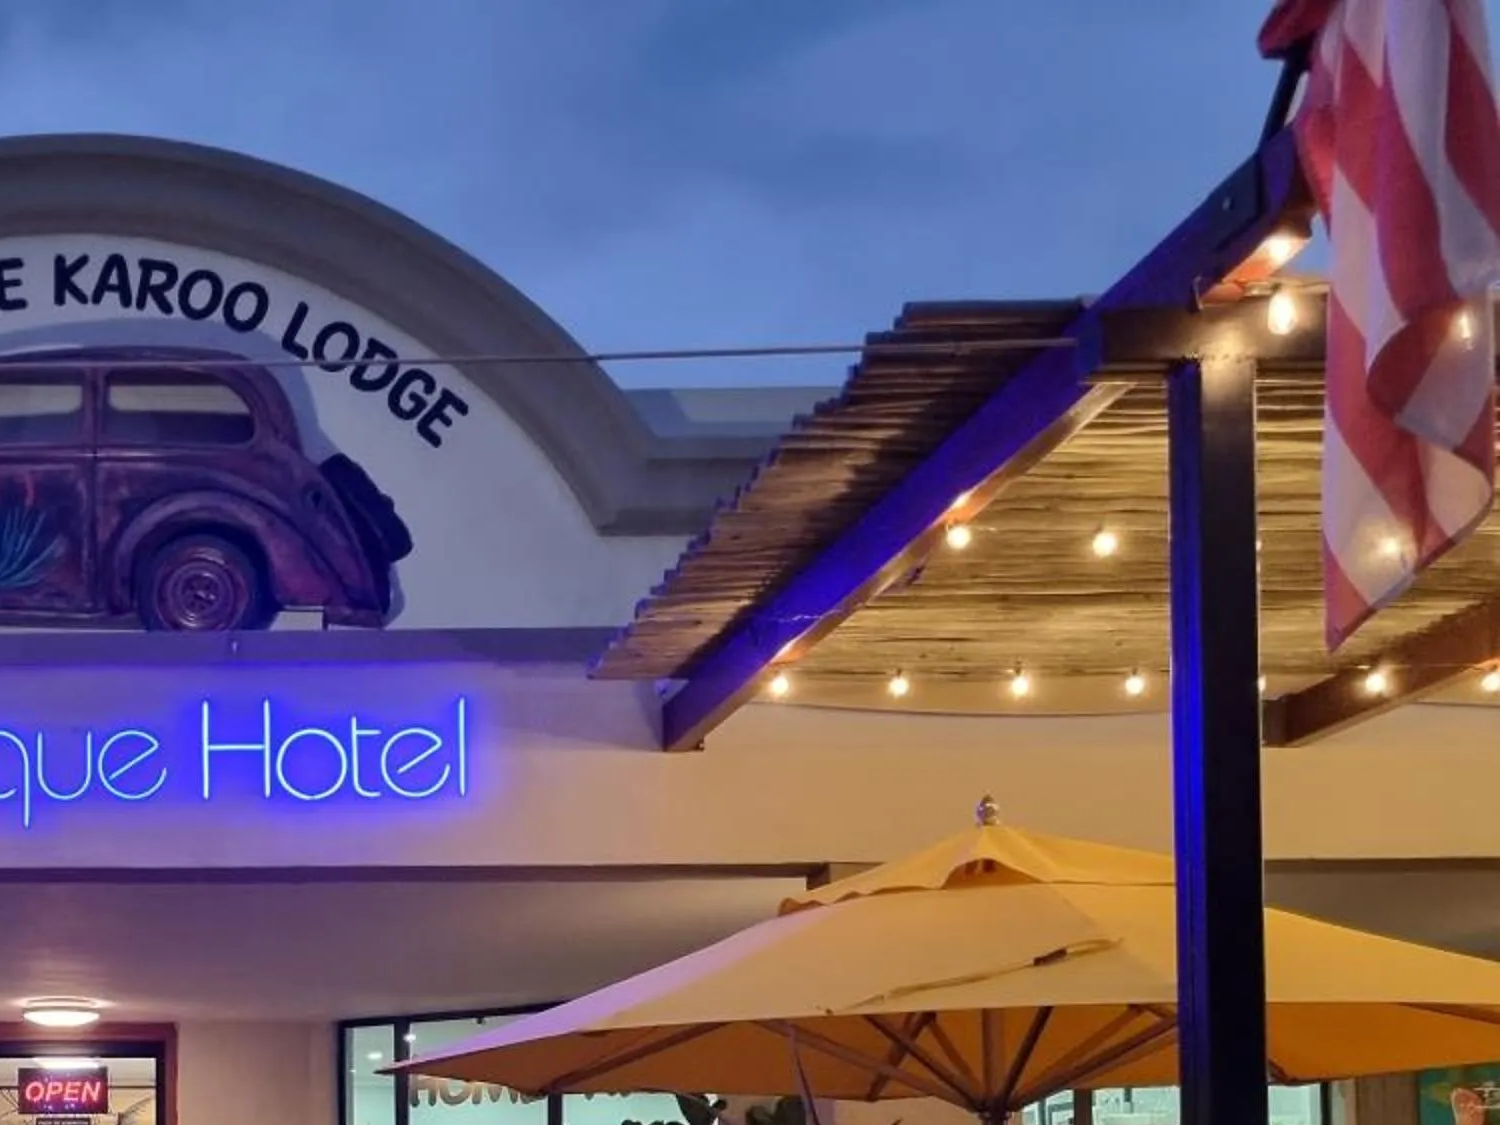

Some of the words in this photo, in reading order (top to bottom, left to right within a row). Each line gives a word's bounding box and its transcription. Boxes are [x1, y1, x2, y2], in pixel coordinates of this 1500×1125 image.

[53, 253, 270, 334] KAROO
[282, 301, 470, 449] LODGE
[202, 697, 467, 800] Hotel
[25, 1081, 101, 1102] OPEN
[411, 1074, 548, 1107] HO
